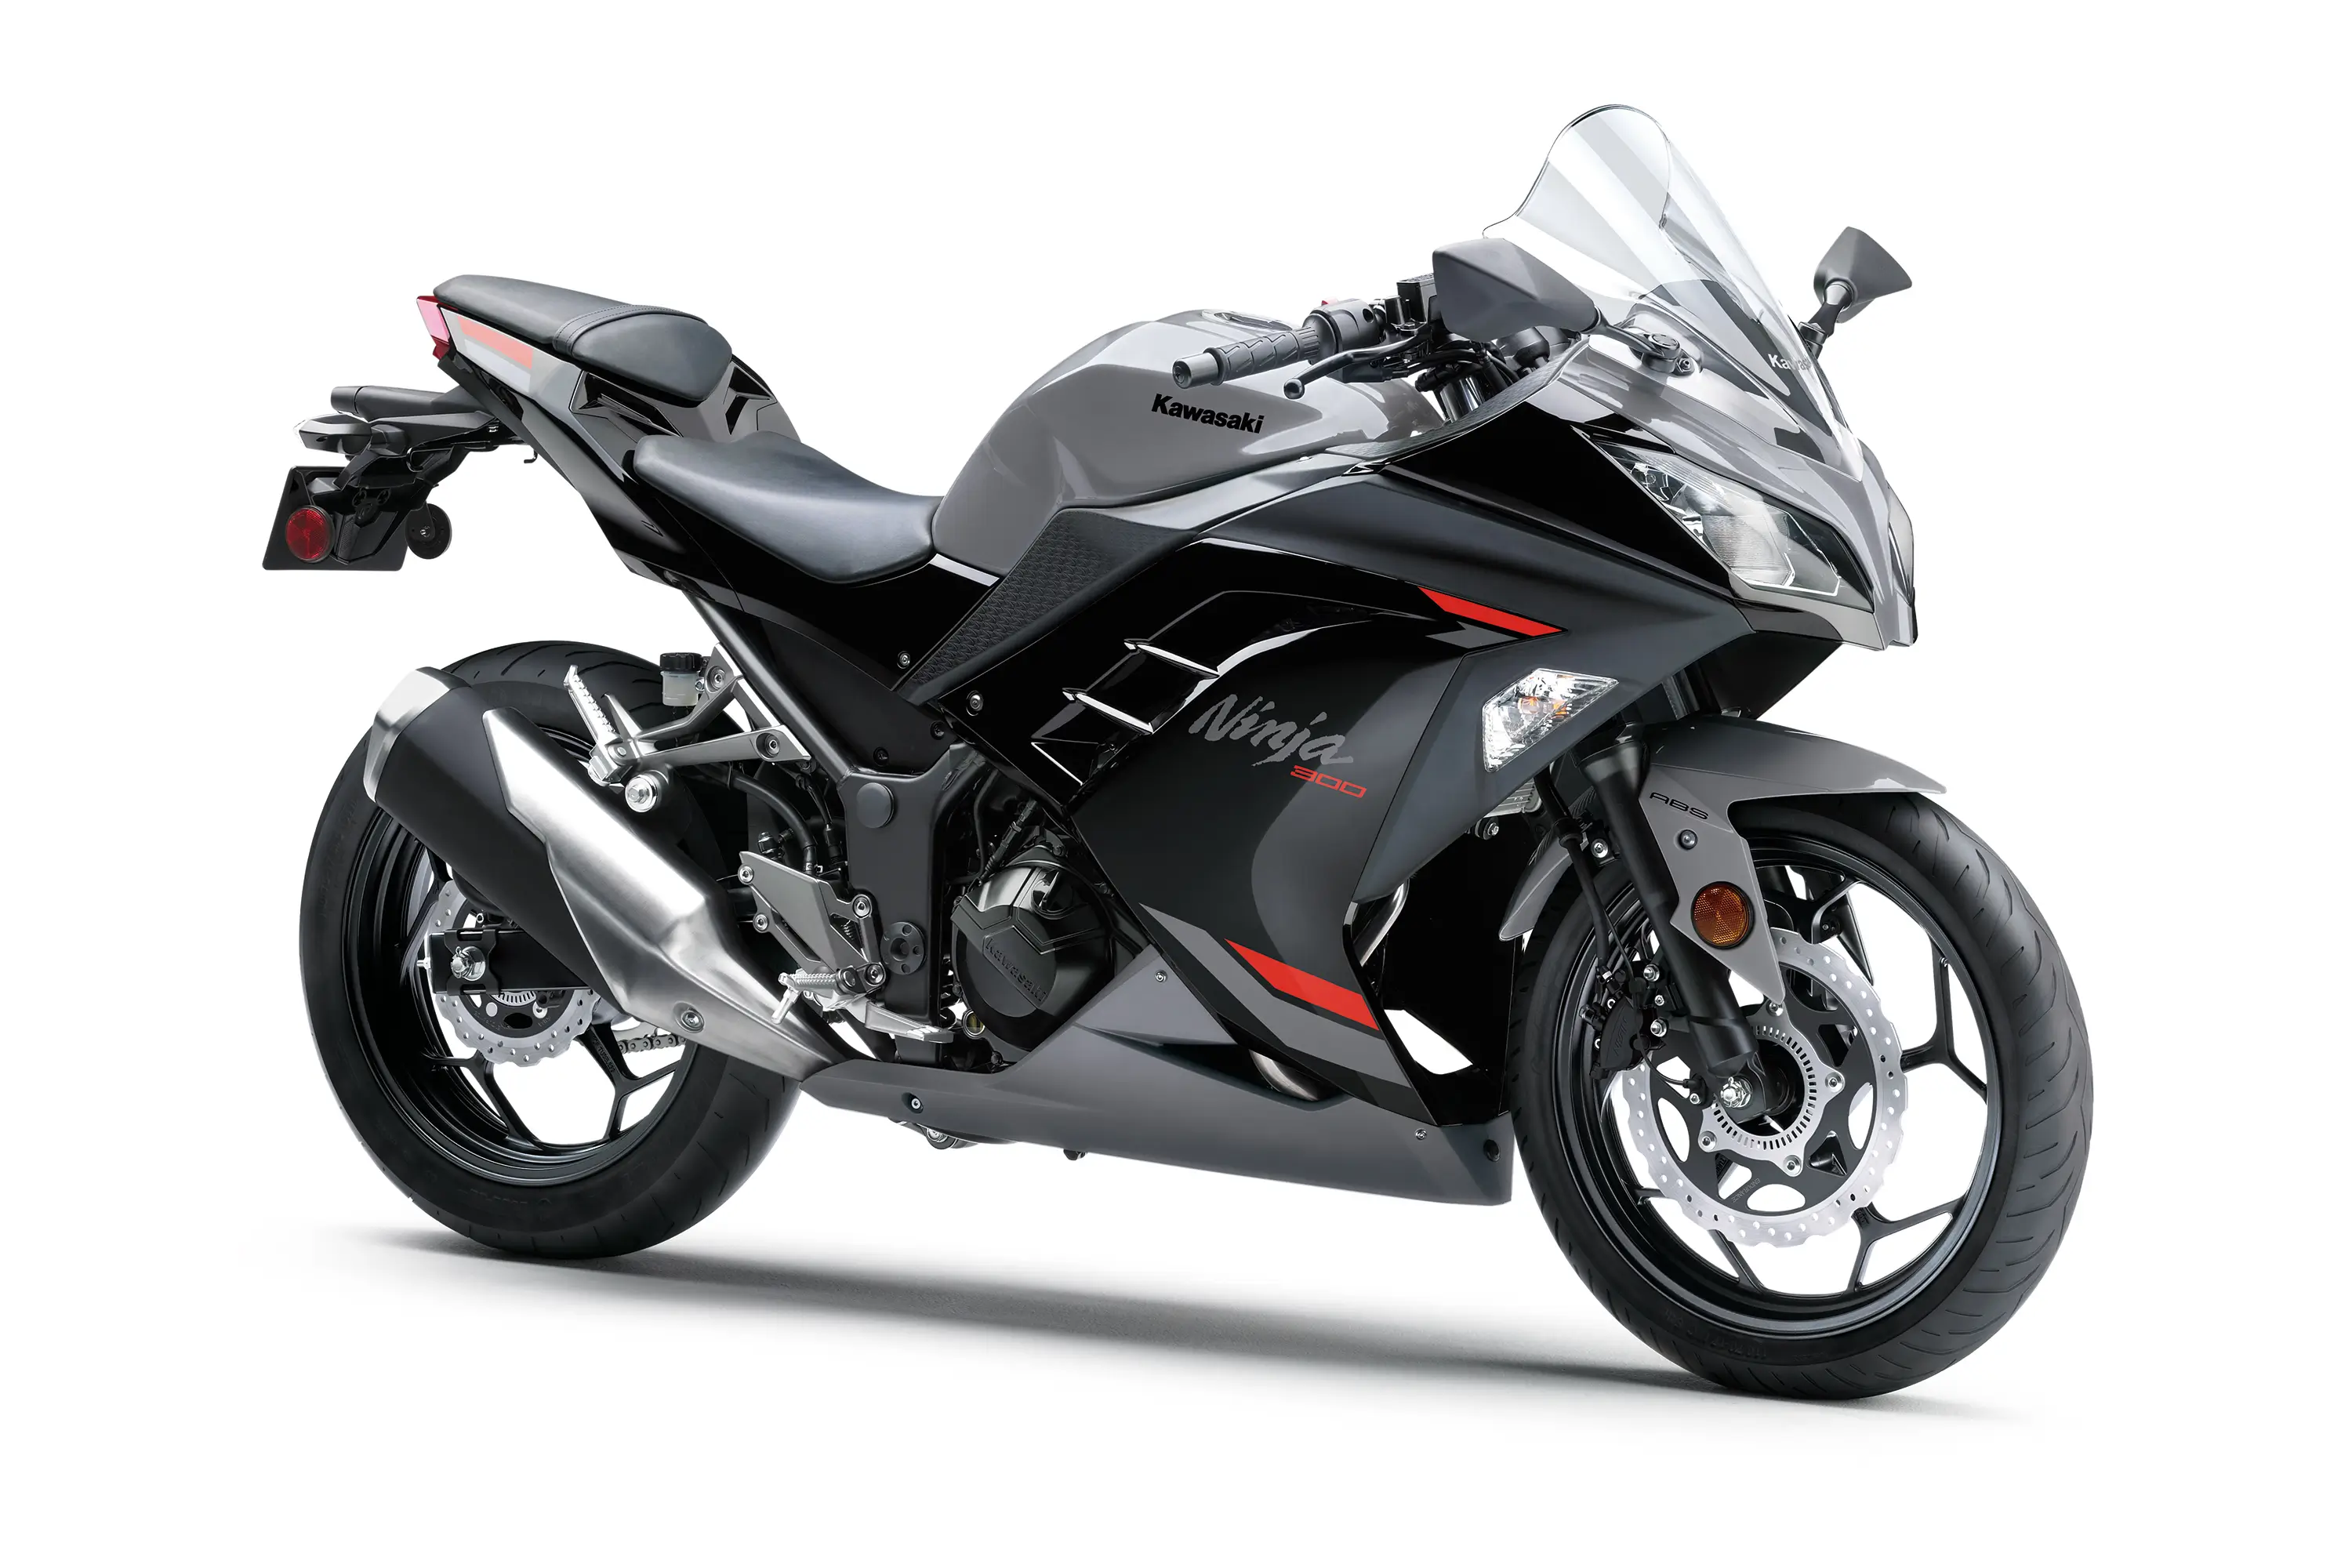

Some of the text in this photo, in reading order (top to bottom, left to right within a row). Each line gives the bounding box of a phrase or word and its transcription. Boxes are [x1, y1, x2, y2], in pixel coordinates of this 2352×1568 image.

[1151, 393, 1265, 434] Kawasaki
[1188, 693, 1354, 767] Ninja
[1290, 764, 1367, 798] 300
[1649, 791, 1709, 820] ABS
[985, 937, 1048, 1003] Kawasaki
[1730, 1177, 1762, 1204] ENDURANCE
